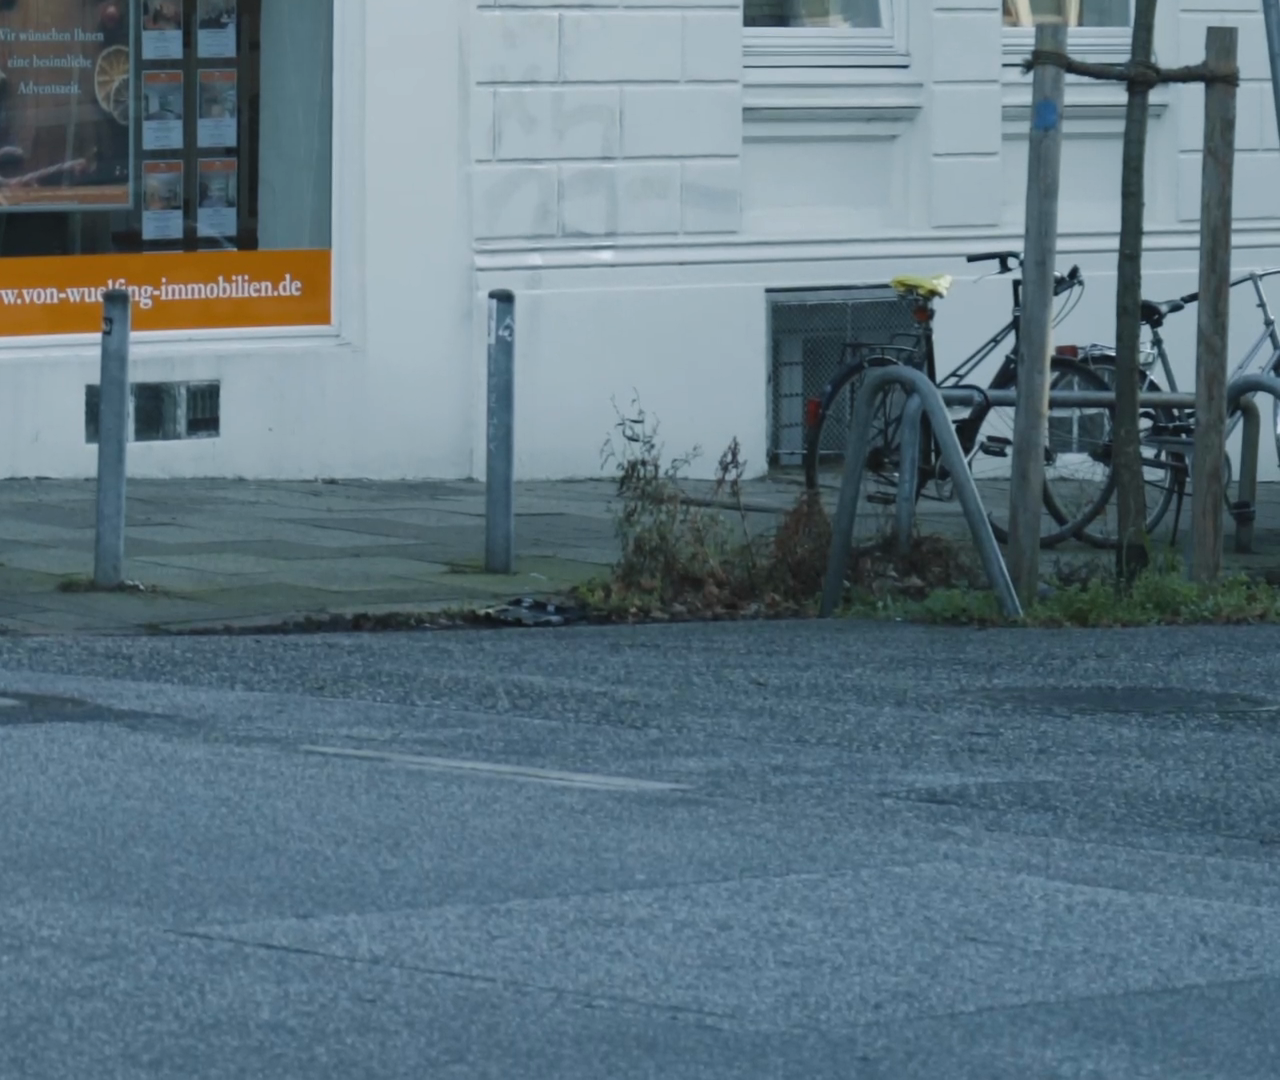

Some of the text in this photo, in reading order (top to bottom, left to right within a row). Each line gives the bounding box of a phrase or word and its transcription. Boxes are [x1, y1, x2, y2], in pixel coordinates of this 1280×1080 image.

[20, 27, 71, 41] wünschen
[74, 27, 105, 41] Ihnen
[7, 54, 92, 68] eine besinnliche
